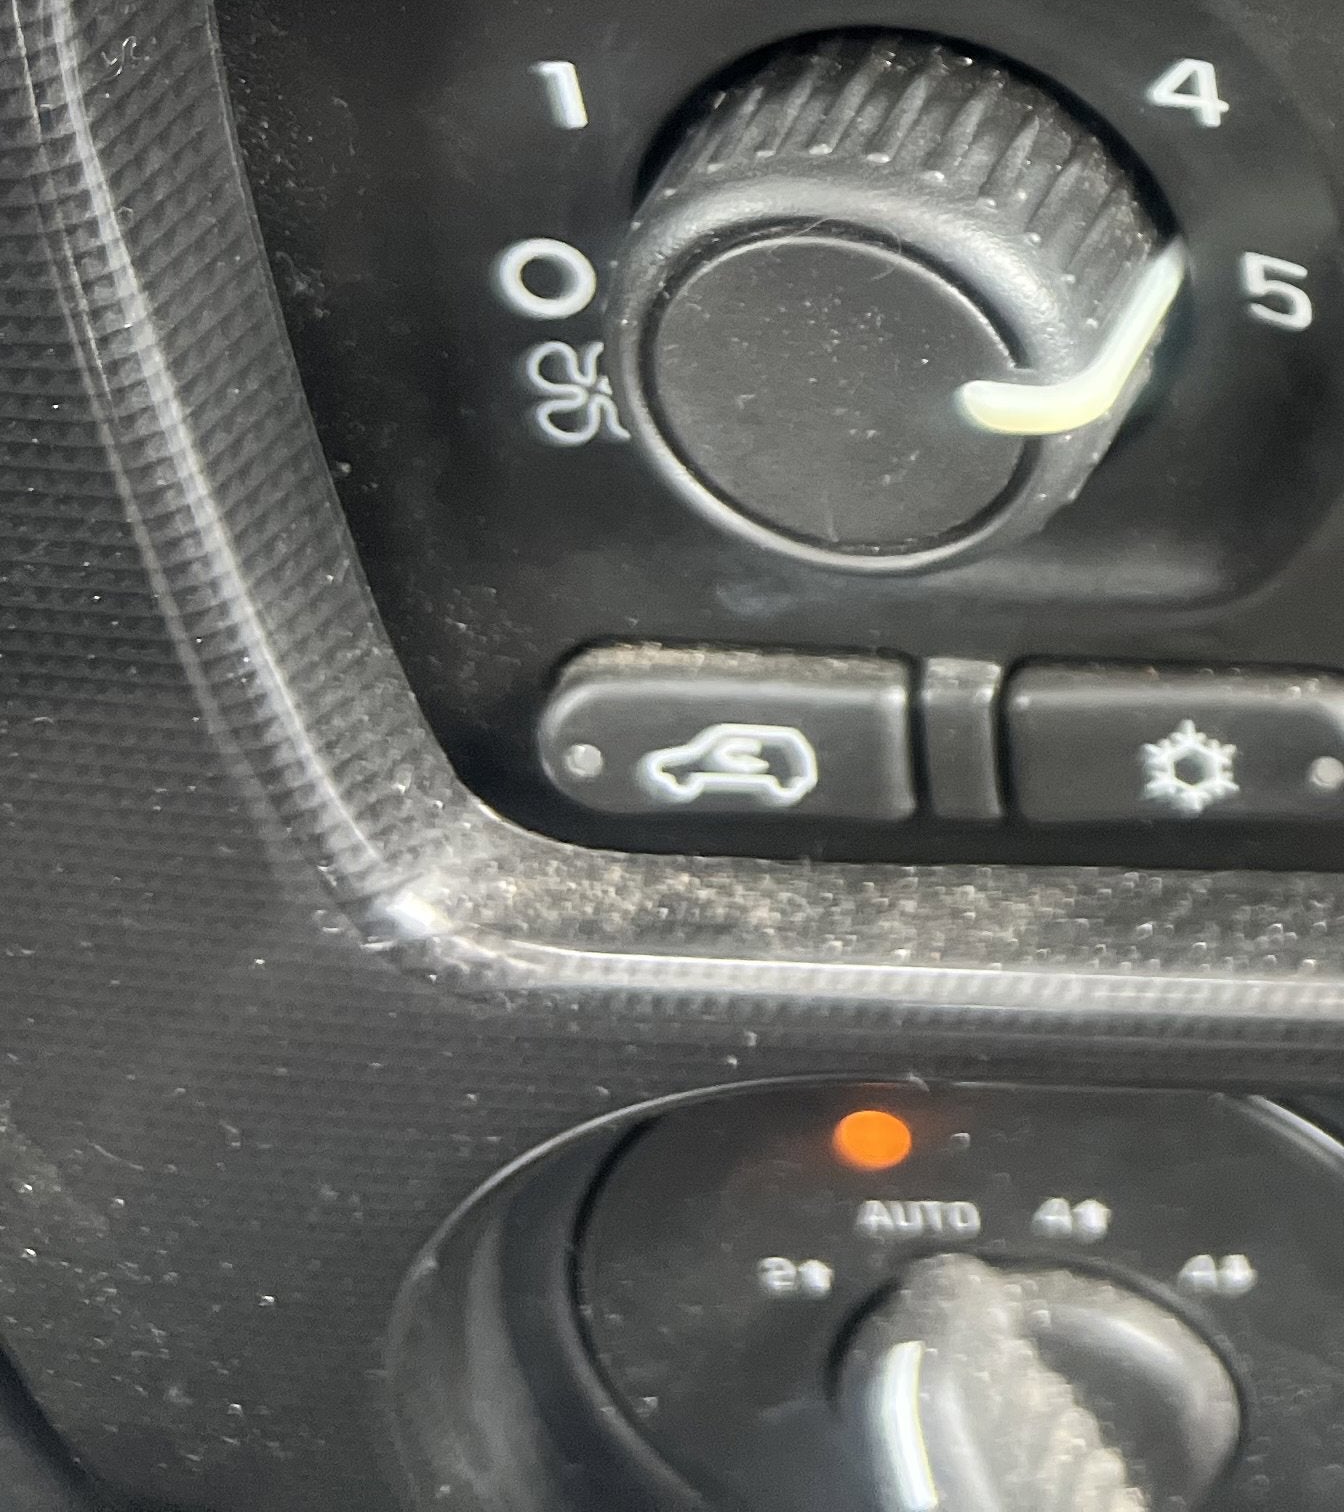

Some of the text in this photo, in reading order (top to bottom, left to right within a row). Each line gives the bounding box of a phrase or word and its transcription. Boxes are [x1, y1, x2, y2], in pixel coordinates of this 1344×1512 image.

[533, 60, 590, 130] 1
[1144, 57, 1231, 129] 4
[1240, 251, 1314, 331] 5
[858, 1199, 982, 1238] AUTO
